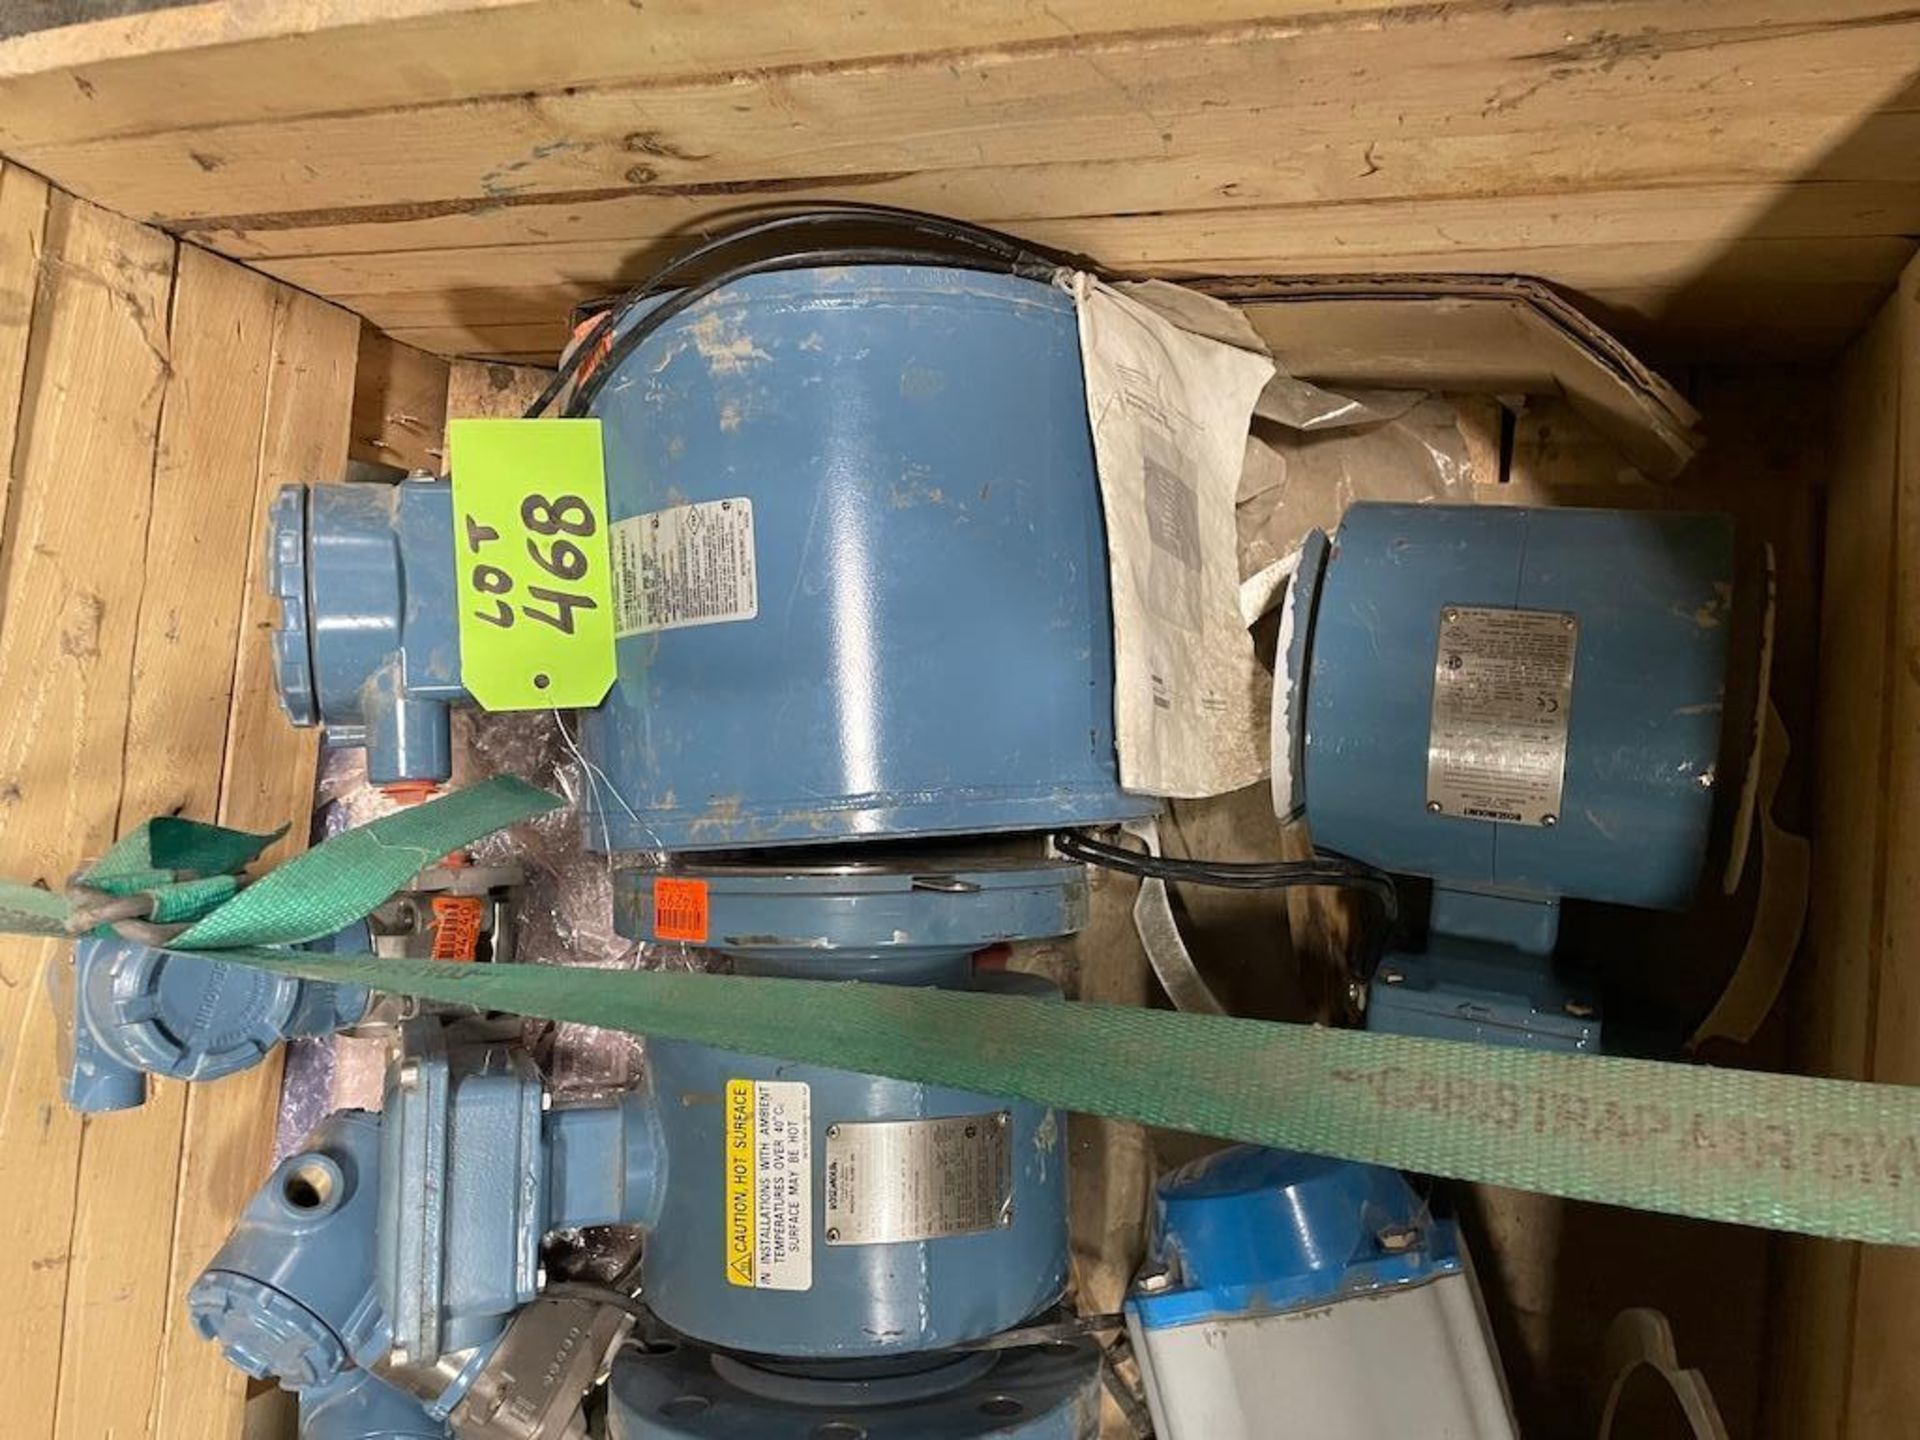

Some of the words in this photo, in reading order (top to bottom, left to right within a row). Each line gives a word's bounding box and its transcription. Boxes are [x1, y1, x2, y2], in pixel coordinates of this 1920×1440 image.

[465, 513, 515, 629] LOT
[520, 494, 598, 635] 468
[732, 1089, 748, 1148] SURFACE
[758, 1086, 770, 1136] AMBIENT
[788, 1120, 799, 1143] HOT
[733, 1158, 746, 1184] HOT
[759, 1144, 770, 1171] WITH
[773, 1140, 785, 1169] OVER
[788, 1150, 799, 1163] BE
[788, 1171, 800, 1196] MAY
[733, 1188, 748, 1253] CAUTION,
[759, 1178, 771, 1264] INSTALLATIONS
[773, 1177, 785, 1264] TEMPERATURES
[788, 1202, 800, 1252] SURFACE
[760, 1273, 771, 1285] IN
